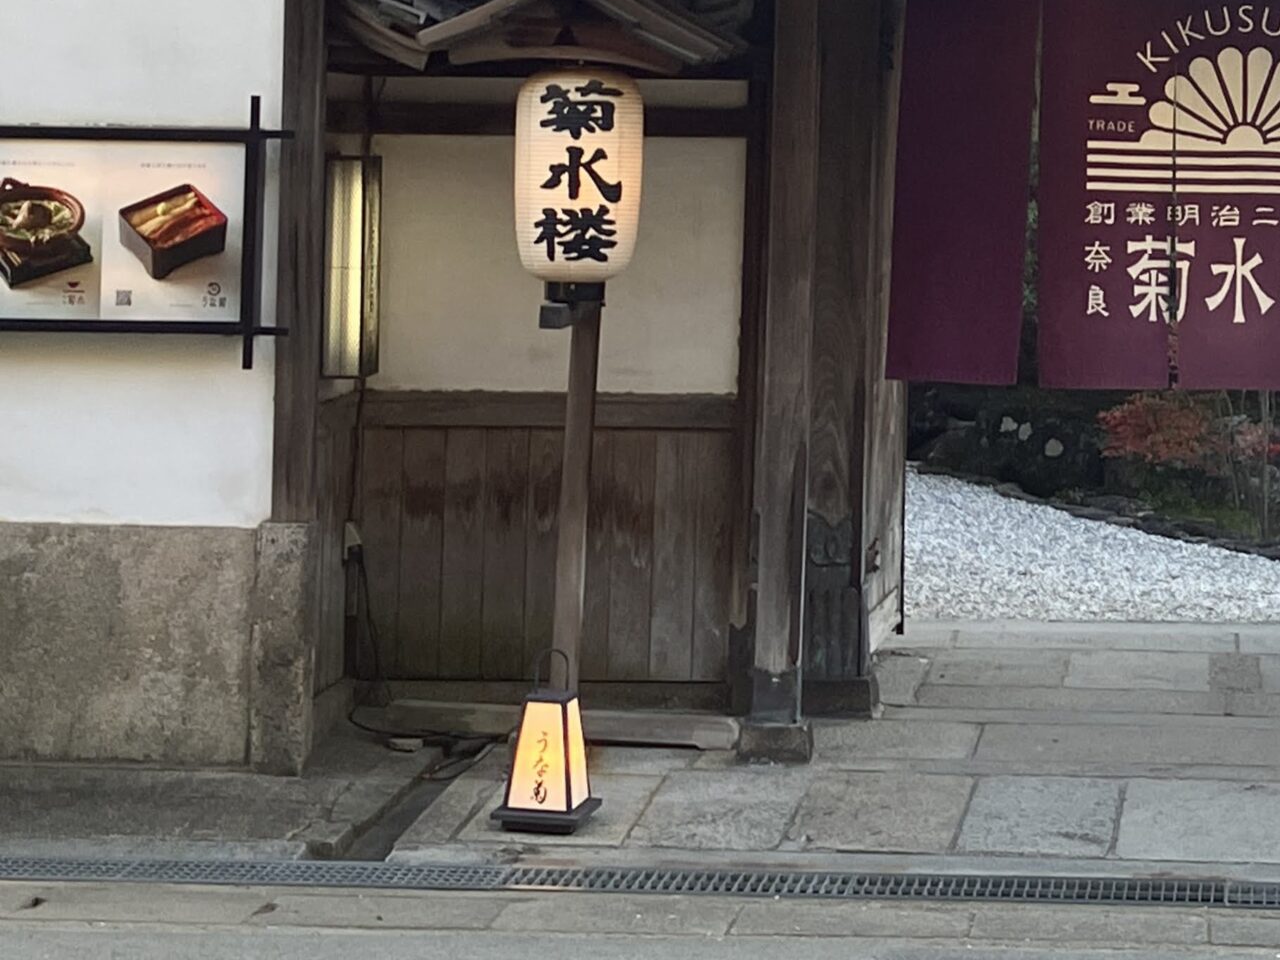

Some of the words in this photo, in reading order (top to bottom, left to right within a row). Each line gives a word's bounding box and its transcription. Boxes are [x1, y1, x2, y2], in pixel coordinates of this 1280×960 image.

[534, 80, 624, 262] 菊水楼
[1088, 119, 1136, 133] TRADE
